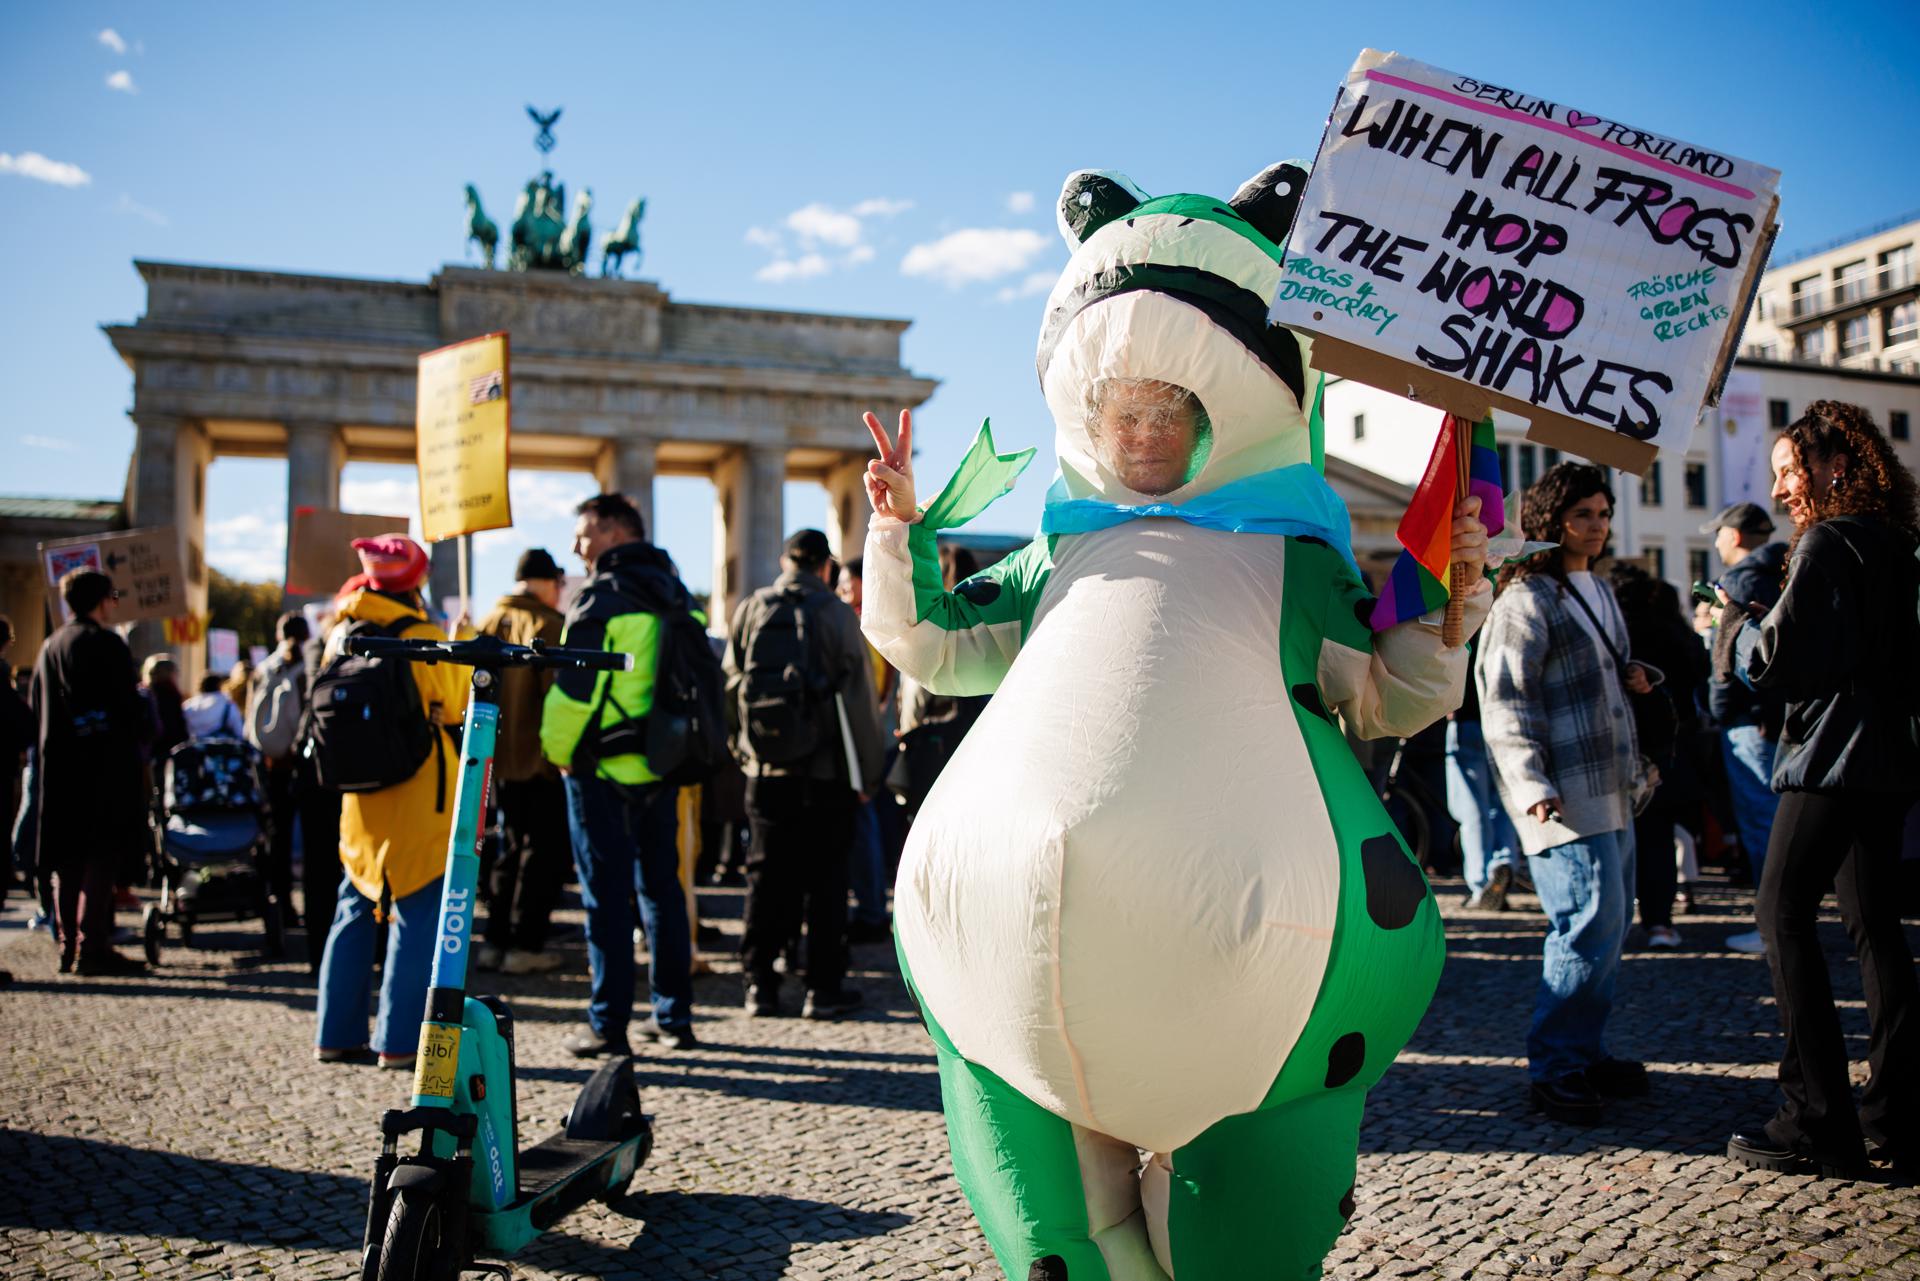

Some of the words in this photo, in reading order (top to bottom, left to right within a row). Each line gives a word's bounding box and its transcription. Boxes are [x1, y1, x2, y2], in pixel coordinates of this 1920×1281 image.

[1452, 76, 1559, 120] BERLIN
[1341, 95, 1504, 180] WHEN
[1501, 144, 1580, 211] ALL
[1585, 168, 1755, 268] FROGS
[1441, 189, 1568, 268] HOP
[1286, 257, 1354, 288] FROGS
[1356, 282, 1378, 304] 4
[1314, 210, 1430, 283] THE
[1416, 251, 1585, 341] WORLD
[1626, 265, 1718, 301] FRÖSCHE
[1640, 287, 1710, 320] GEGEN
[1279, 280, 1399, 336] DEMOCRACY
[1415, 314, 1673, 441] SHAKES
[442, 887, 469, 954] dott
